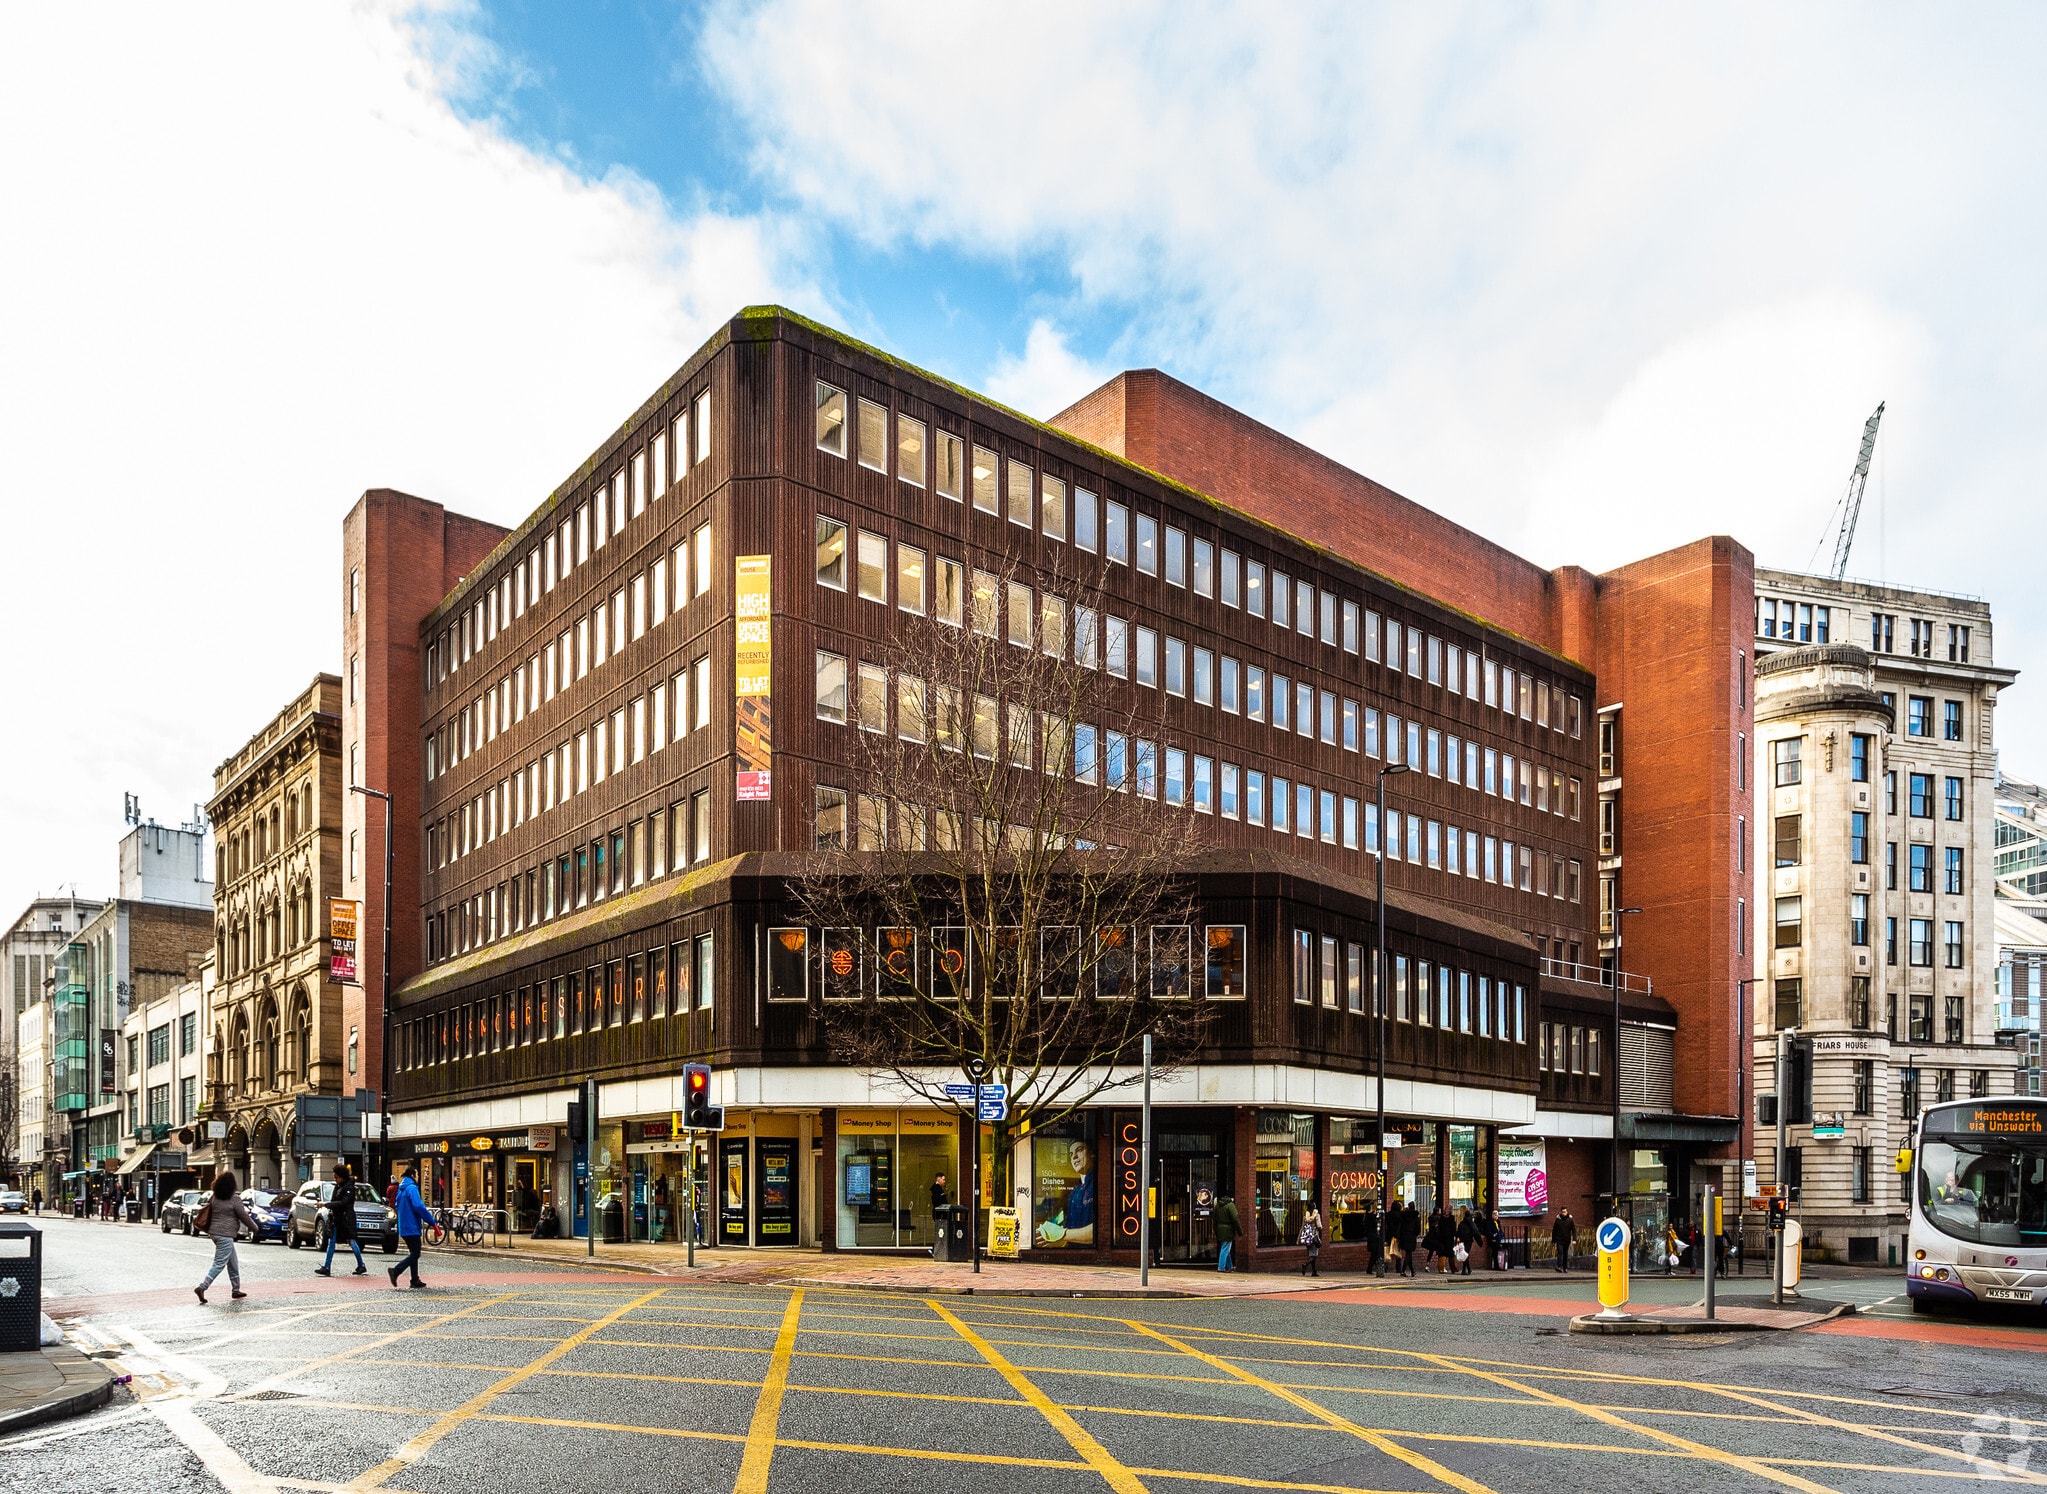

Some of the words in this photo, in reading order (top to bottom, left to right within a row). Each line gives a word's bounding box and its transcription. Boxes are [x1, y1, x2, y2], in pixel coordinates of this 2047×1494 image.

[738, 594, 768, 608] HIGH
[738, 608, 769, 617] QUALITY
[738, 622, 768, 632] OFFICE
[738, 632, 768, 643] SPACE
[737, 651, 769, 659] RECENTLY
[738, 677, 750, 686] TO
[752, 676, 769, 686] LET
[332, 919, 355, 930] OFFICE
[333, 927, 354, 937] SPACE
[333, 938, 342, 946] TO
[343, 940, 355, 949] LET
[1845, 1041, 1868, 1050] HOUSE
[1974, 1110, 2038, 1121] Manchester
[852, 1120, 874, 1128] Money
[875, 1120, 892, 1128] Shop
[913, 1120, 935, 1128] Money
[937, 1120, 954, 1128] Shop
[1391, 1123, 1422, 1132] COSMO
[1969, 1120, 1985, 1131] via
[1989, 1121, 2042, 1132] Unsworth
[1042, 1177, 1065, 1185] Dishes
[1121, 1123, 1140, 1235] COSMO
[1330, 1171, 1377, 1190] COSMO
